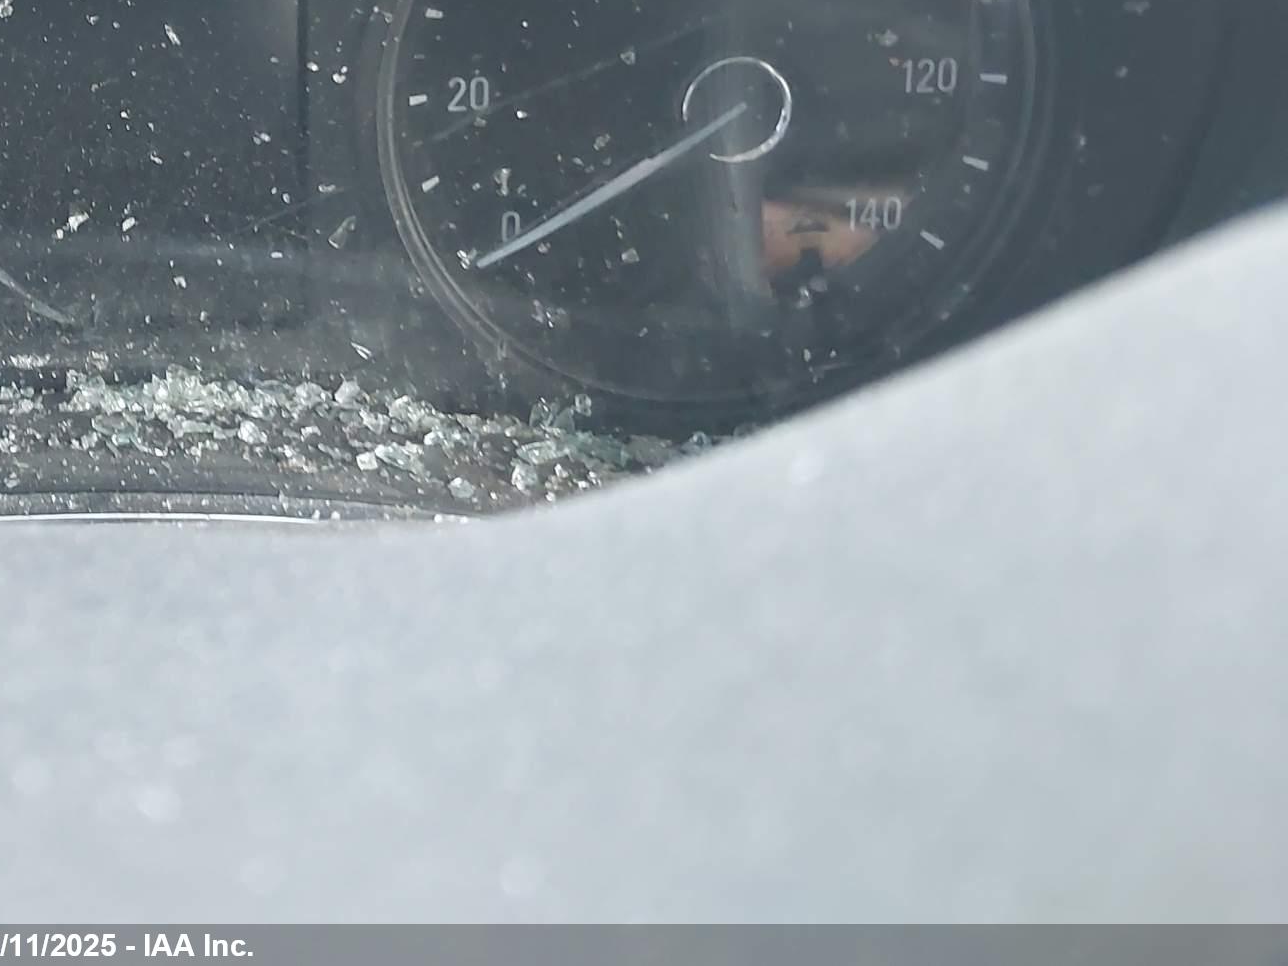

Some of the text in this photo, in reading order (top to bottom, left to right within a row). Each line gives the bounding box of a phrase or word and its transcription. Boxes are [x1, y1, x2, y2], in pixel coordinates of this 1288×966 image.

[902, 58, 957, 94] 120
[447, 77, 490, 112] 20
[846, 197, 902, 231] 140
